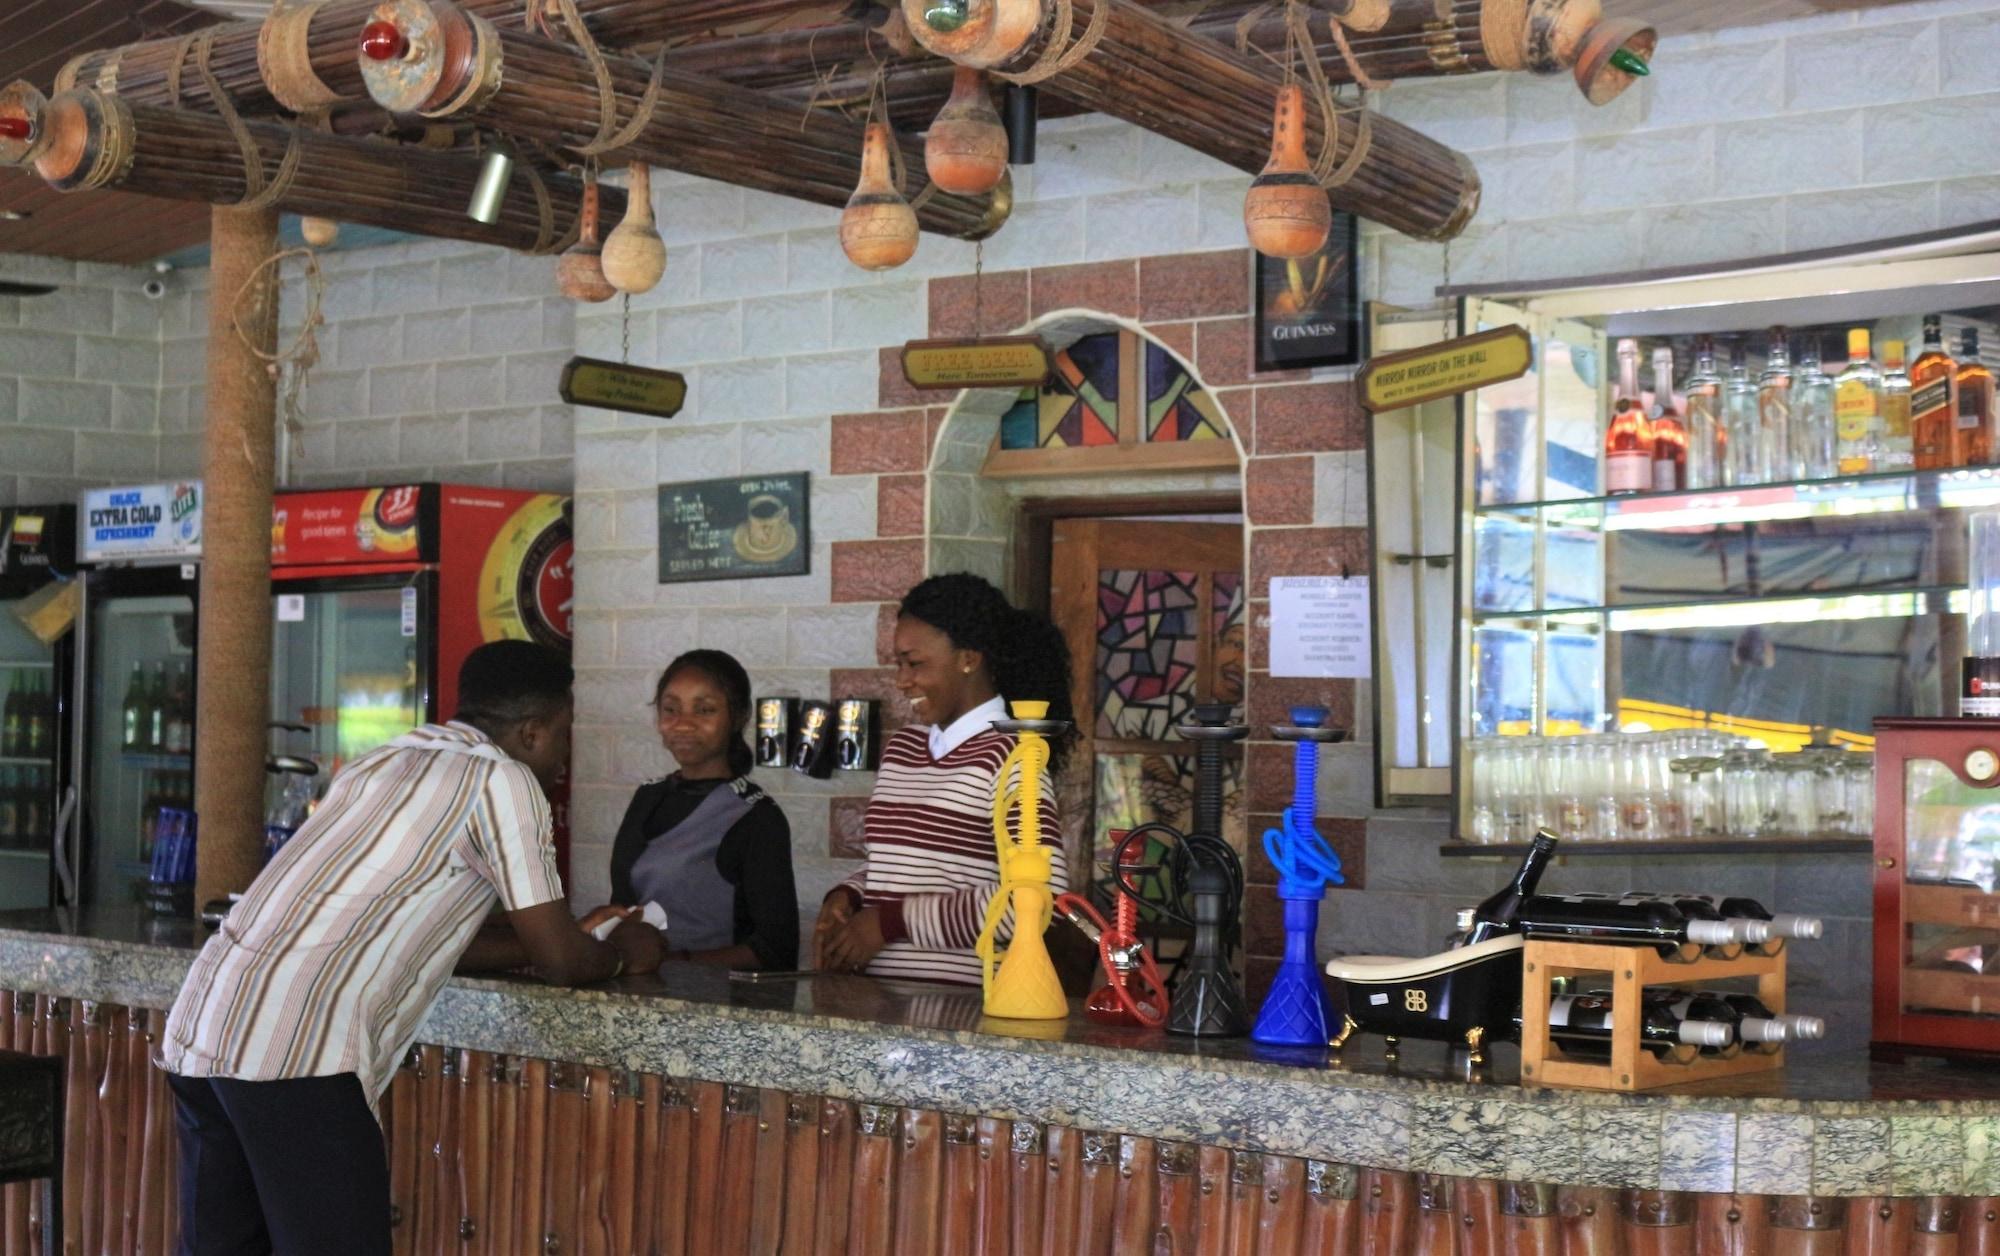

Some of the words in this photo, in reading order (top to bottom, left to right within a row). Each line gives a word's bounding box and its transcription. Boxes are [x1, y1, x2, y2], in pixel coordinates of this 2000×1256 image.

[1272, 323, 1336, 340] GUINNESS
[1376, 369, 1406, 386] MIRROR
[1408, 362, 1437, 377] MIRROR
[1439, 359, 1450, 372] ON
[1453, 355, 1466, 367] THE
[1468, 350, 1487, 363] WALL
[110, 492, 141, 506] UNLOCK
[90, 508, 128, 527] EXTRA
[130, 504, 162, 524] COLD
[302, 508, 329, 521] Recipe
[330, 508, 343, 518] for
[673, 494, 705, 523] Fresh
[95, 525, 156, 541] REFRESHMENT
[301, 527, 323, 541] good
[688, 521, 721, 550] Coffee
